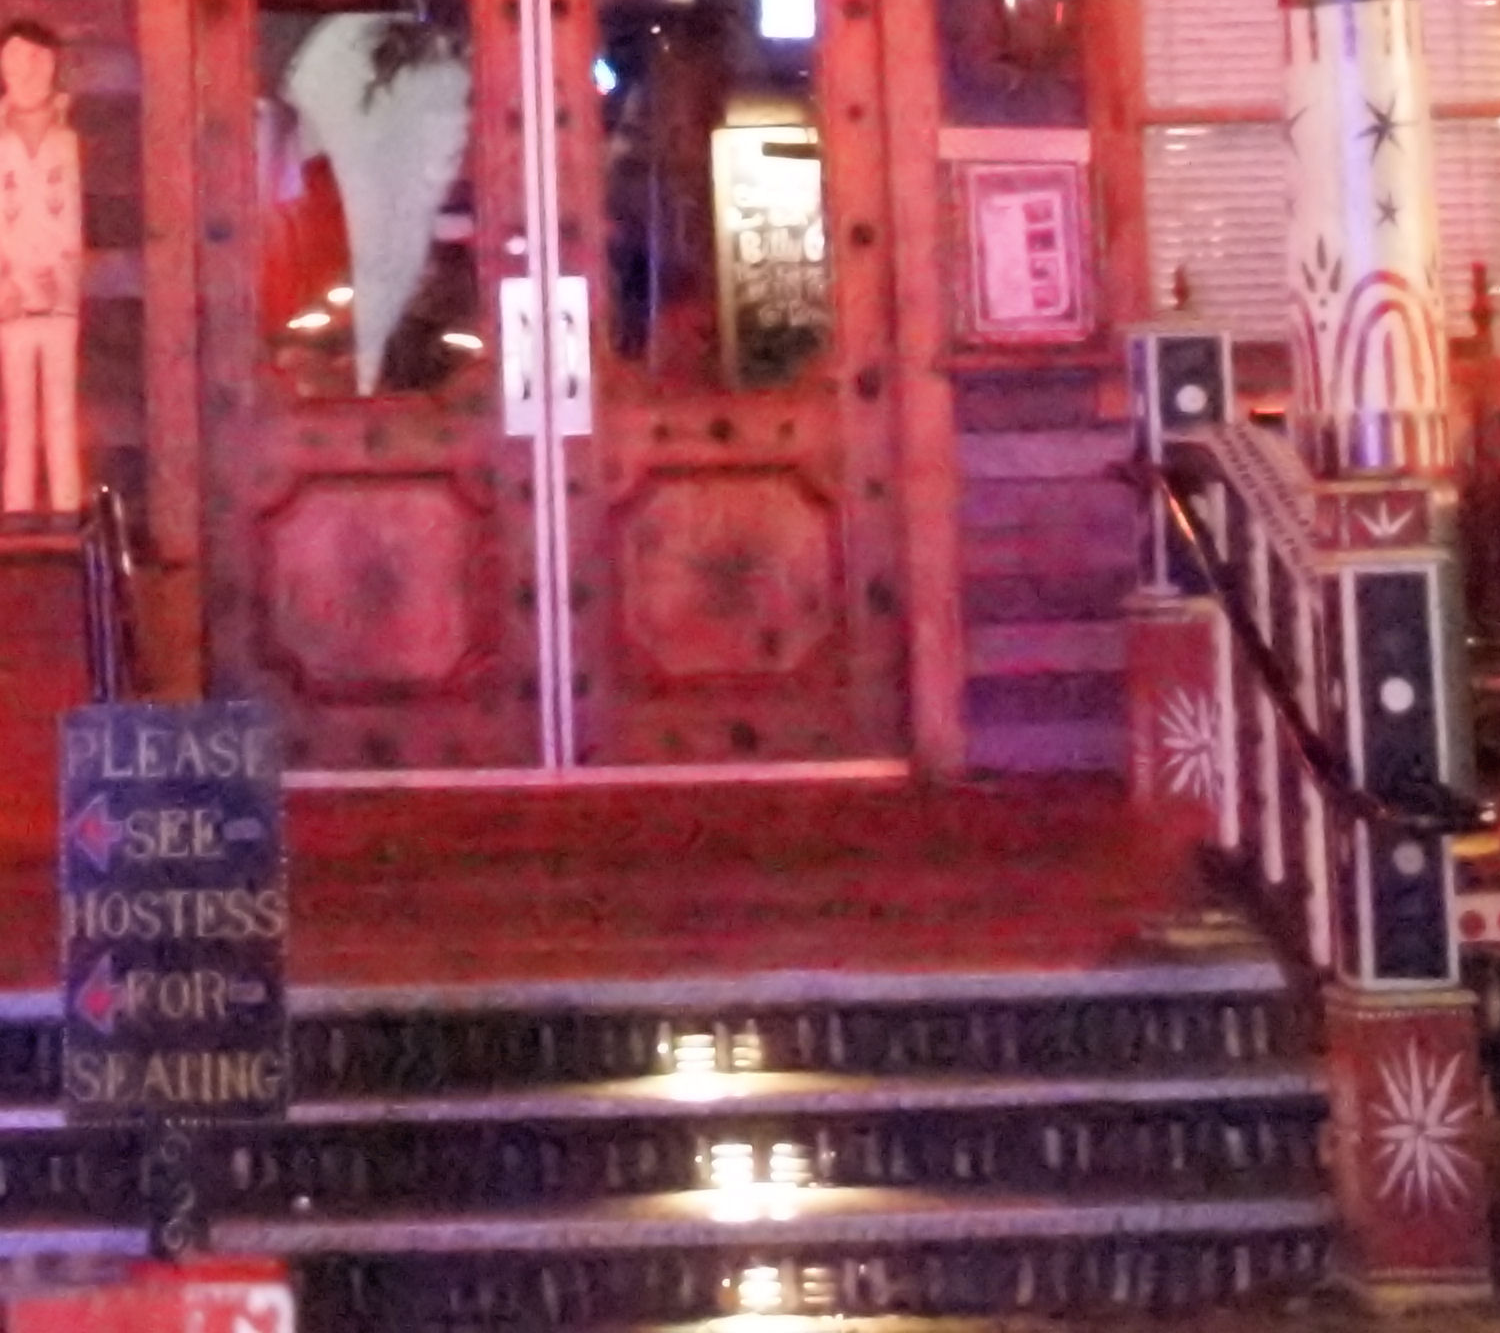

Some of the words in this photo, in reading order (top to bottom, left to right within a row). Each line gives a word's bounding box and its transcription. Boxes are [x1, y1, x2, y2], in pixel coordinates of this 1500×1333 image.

[66, 729, 278, 779] PLEASE
[122, 807, 226, 861] SEE
[64, 887, 284, 940] HOSTESS
[121, 969, 229, 1021] FOR
[66, 1048, 284, 1104] SEATING
